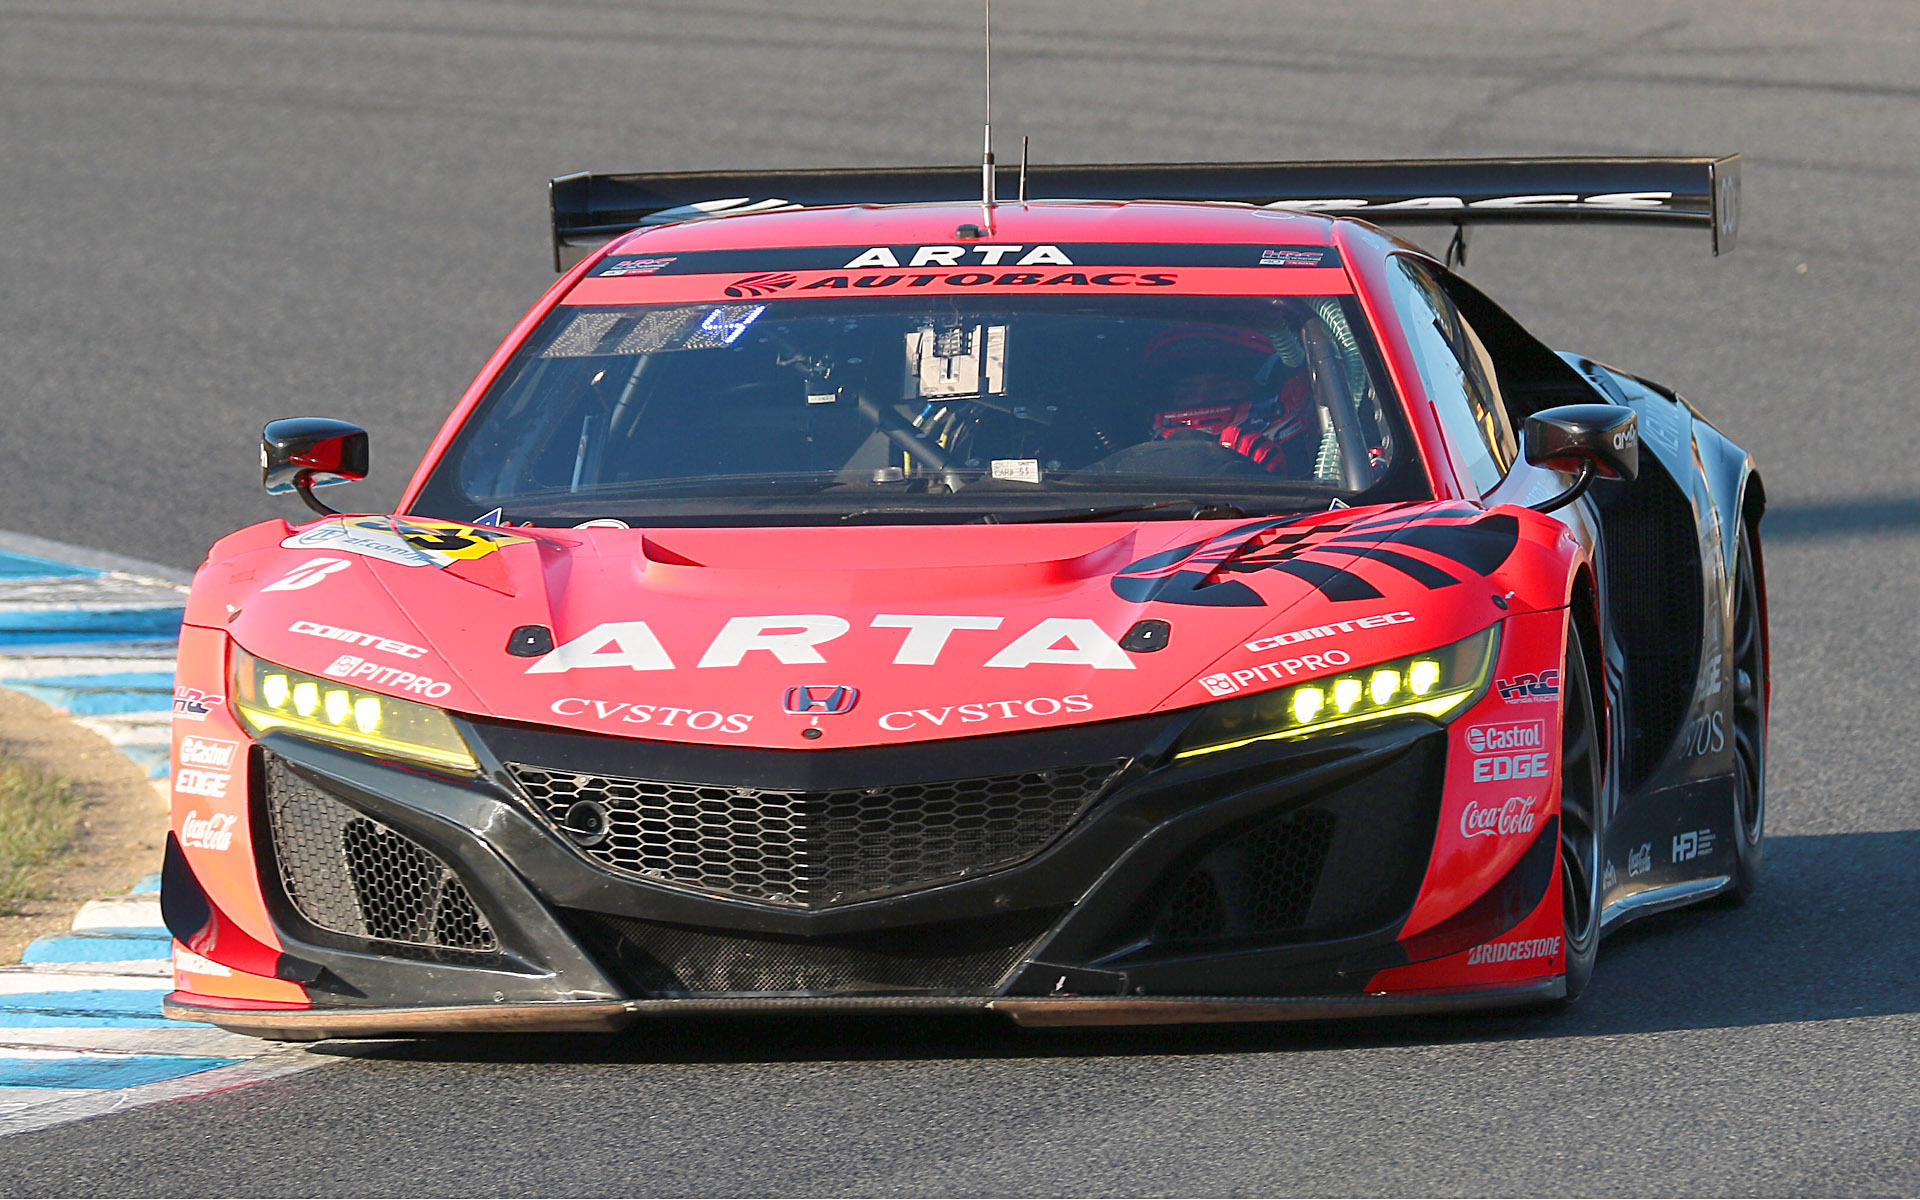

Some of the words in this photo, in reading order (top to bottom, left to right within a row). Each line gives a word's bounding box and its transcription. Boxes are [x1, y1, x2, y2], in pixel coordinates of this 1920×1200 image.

[843, 245, 1075, 268] ARTA
[798, 273, 1179, 291] AUTOBACS
[288, 621, 429, 659] COMTEC
[524, 614, 1137, 674] ARTA
[1244, 611, 1416, 652] COMTEC
[349, 662, 452, 698] PITPRO
[1231, 650, 1351, 687] PITPRO
[1495, 669, 1560, 700] HRC
[550, 697, 754, 735] CVSTOS
[877, 694, 1093, 732] CVSTOS
[1486, 724, 1541, 750] Castrol
[175, 769, 232, 798] EDGE
[1473, 753, 1549, 783] EDGE
[1467, 936, 1561, 965] BRIDGESTONE
